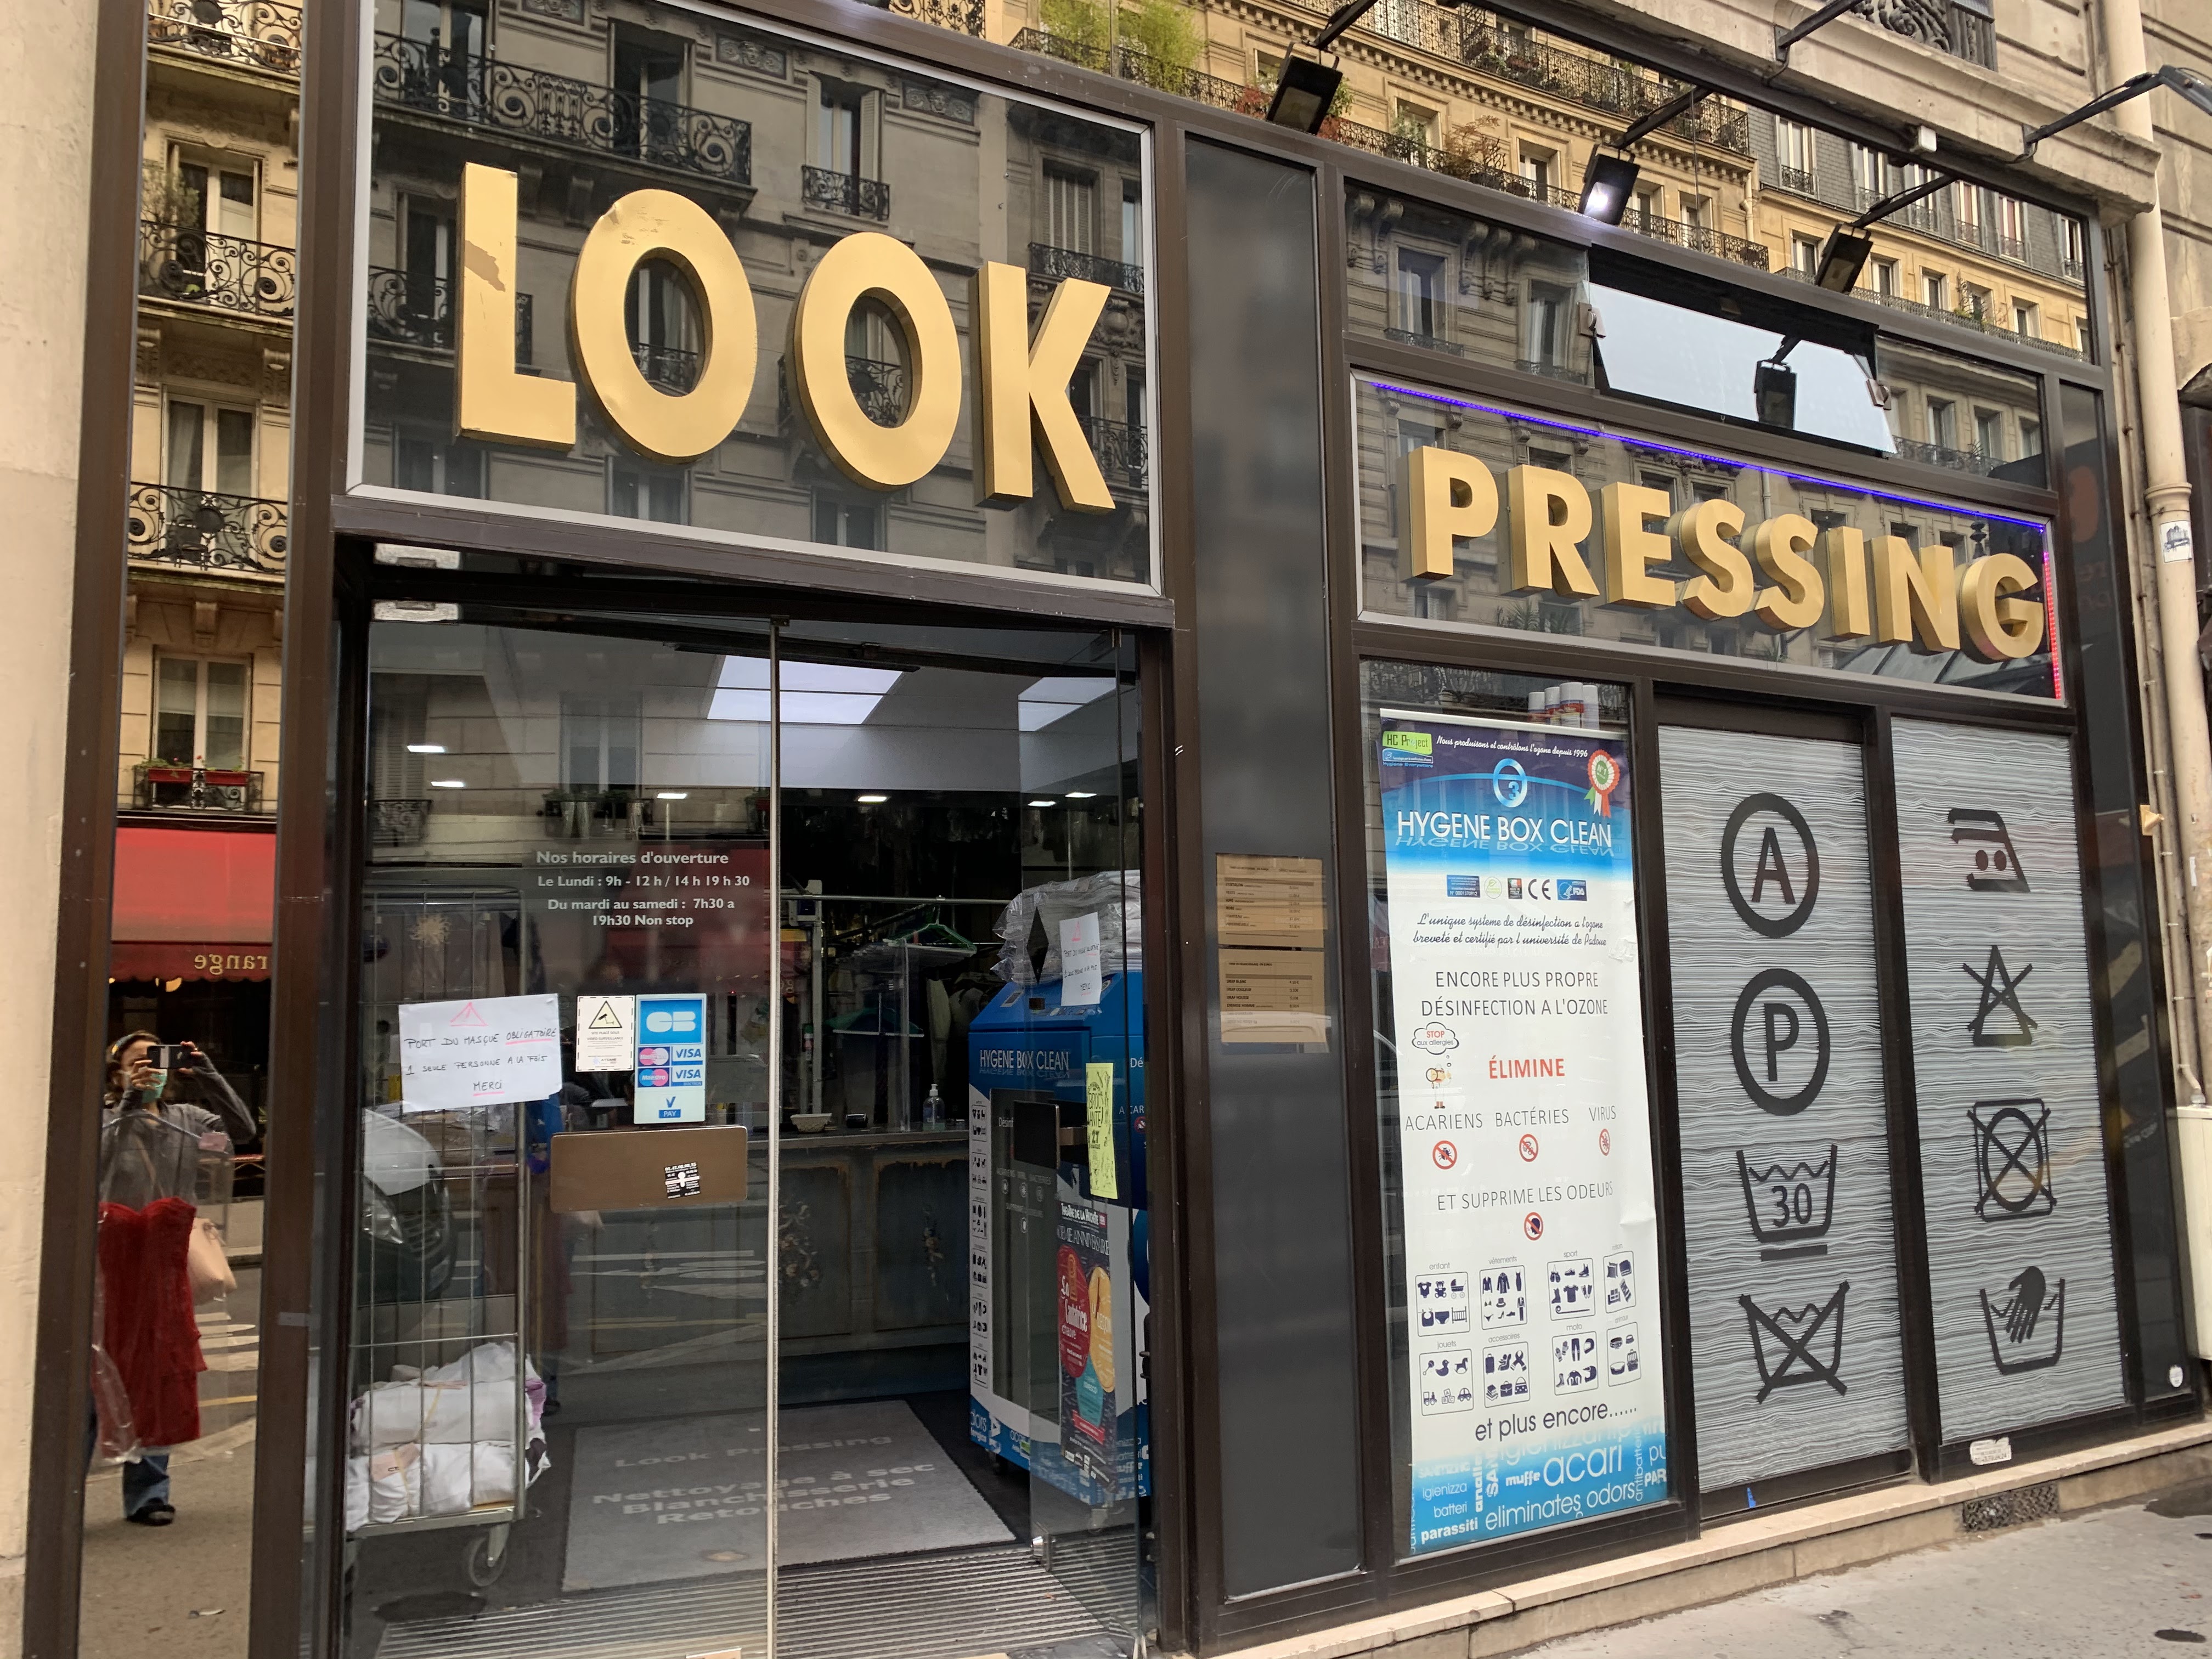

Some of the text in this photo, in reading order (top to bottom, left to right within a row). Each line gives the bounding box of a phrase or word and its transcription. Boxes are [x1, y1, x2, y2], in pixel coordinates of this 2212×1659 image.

[456, 162, 1116, 511] LOOK
[1404, 445, 2044, 660] PRESSING
[1387, 734, 1398, 746] HC
[1436, 735, 1588, 758] Nous produisons et contrôlons l'ozone depuis 1996
[1397, 810, 1612, 848] HYGENE BOX CLEAN
[536, 851, 729, 864] Nos horaires d'ouverture
[1752, 827, 1796, 904] A
[538, 876, 554, 887] Le
[557, 876, 594, 887] Lundi
[605, 876, 622, 887] 9h
[635, 876, 651, 886] 12
[654, 876, 662, 886] h
[675, 876, 689, 886] 14
[692, 876, 701, 886] h
[706, 876, 720, 886] 19
[723, 876, 731, 886] h
[735, 876, 750, 886] 30
[1528, 878, 1551, 900] CE
[548, 900, 567, 910] Du
[571, 899, 610, 910] mardi
[613, 901, 629, 910] au
[633, 899, 678, 910] samedi
[693, 898, 724, 909] 7h30
[593, 915, 693, 928] 19h30 Non stop
[1417, 913, 1466, 929] L'unique
[1468, 914, 1501, 930] systeme
[1503, 915, 1514, 927] de
[1516, 915, 1572, 932] désinfection
[1413, 930, 1451, 943] breveté
[1453, 931, 1463, 943] et
[1465, 931, 1496, 948] certifié
[1497, 936, 1514, 948] par
[1522, 933, 1569, 945] université
[1572, 933, 1582, 945] de
[1436, 972, 1599, 988] ENCORE PLUS PROPRE
[1422, 996, 1608, 1016] DÉSINFECTION A L'OZONE
[646, 1011, 696, 1032] CB
[404, 1039, 436, 1048] PORT
[1765, 1003, 1799, 1081] P
[676, 1048, 701, 1058] VISA
[980, 1049, 1069, 1070] HYGENE BOX CLEAN
[454, 1059, 500, 1069] PERSONNE
[1489, 1055, 1565, 1079] ÉLIMINE
[676, 1069, 701, 1079] VISA
[1405, 1105, 1616, 1131] ACARIENS BACTÉRIES VIRUS
[1438, 1181, 1613, 1210] ET SUPPRIME LES ODEURS
[1772, 1183, 1813, 1227] 30
[1564, 1250, 1578, 1259] sport
[1437, 1340, 1457, 1349] jouets
[1488, 1333, 1520, 1342] accessoires
[1475, 1418, 1492, 1441] et
[1499, 1414, 1536, 1441] plus
[615, 1453, 712, 1467] Look
[1543, 1437, 1622, 1487] acari
[830, 1470, 852, 1481] à
[866, 1464, 935, 1477] sec
[1506, 1470, 1540, 1487] muffe
[1645, 1468, 1667, 1487] PAR
[1434, 1501, 1468, 1518] batteri
[1485, 1482, 1635, 1531] eliminates odors
[1421, 1517, 1479, 1544] parassiti
